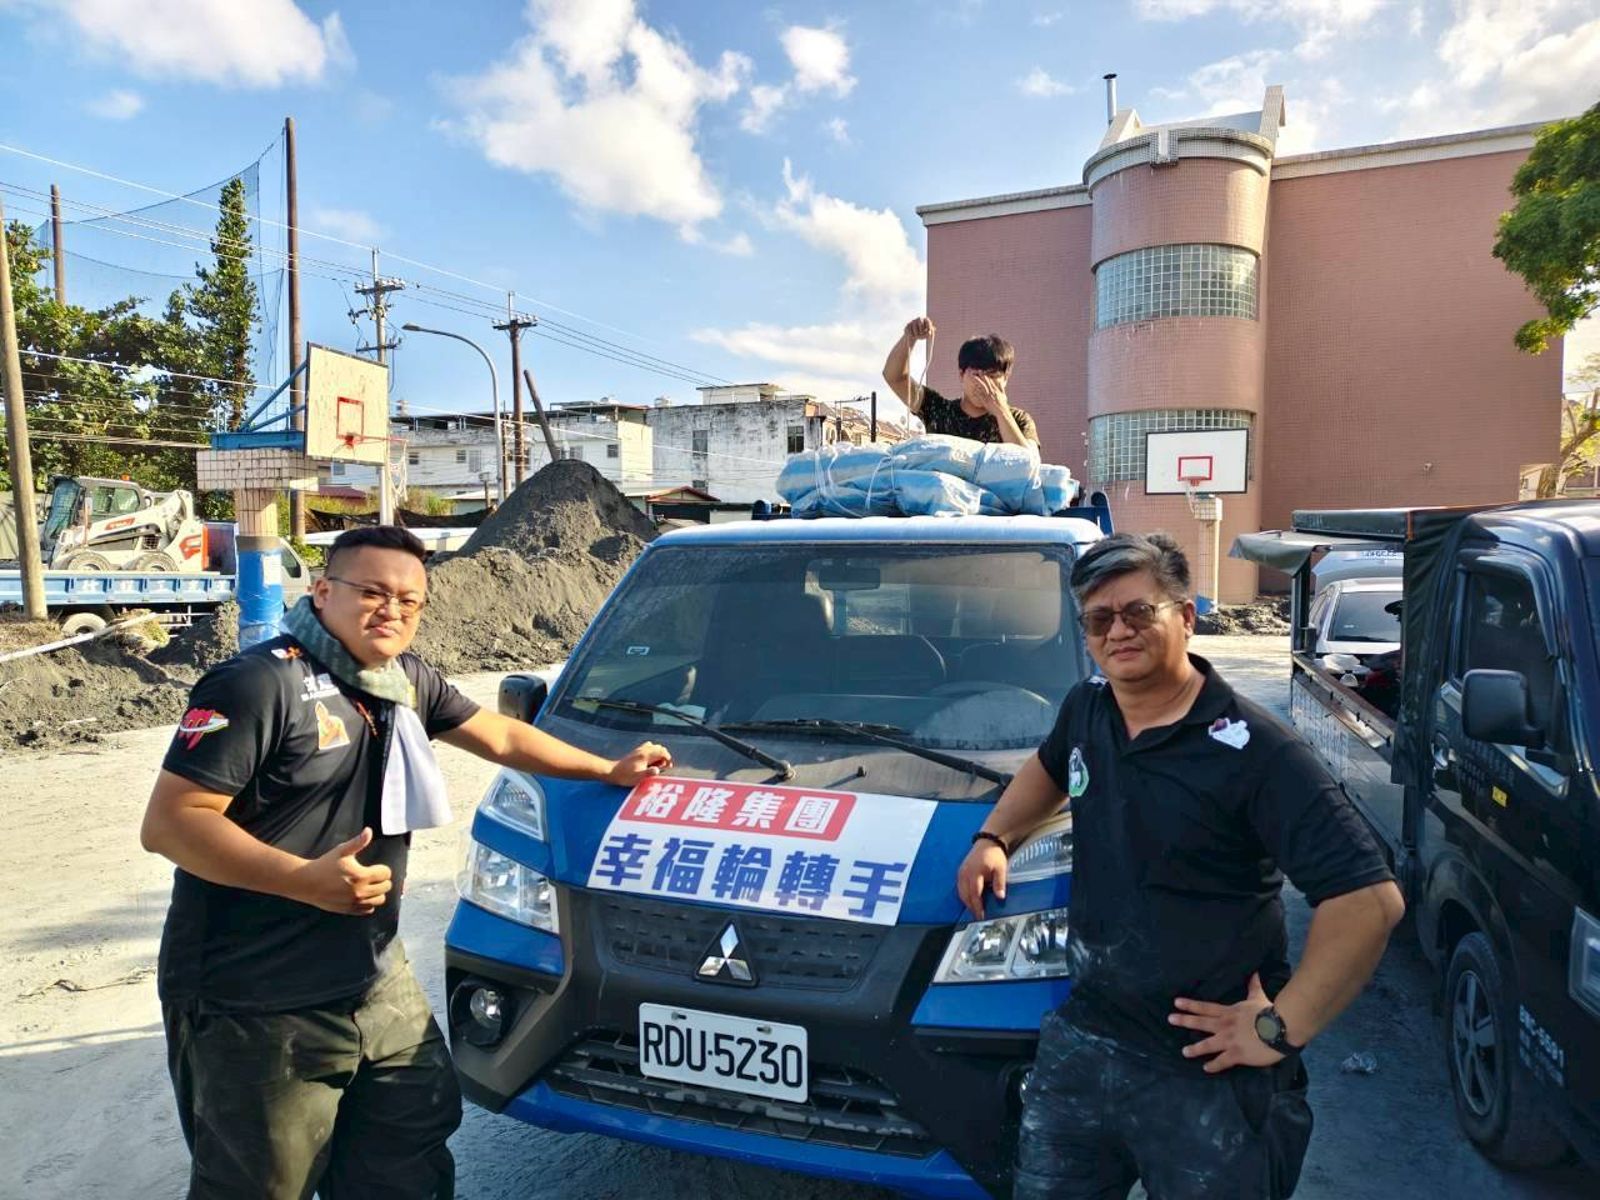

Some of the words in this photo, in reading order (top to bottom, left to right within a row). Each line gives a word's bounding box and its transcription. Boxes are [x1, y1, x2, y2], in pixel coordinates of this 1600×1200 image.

[633, 783, 840, 834] 裕隆集團
[595, 833, 908, 918] 幸福輪轉手
[643, 1021, 803, 1088] RDU-5230
